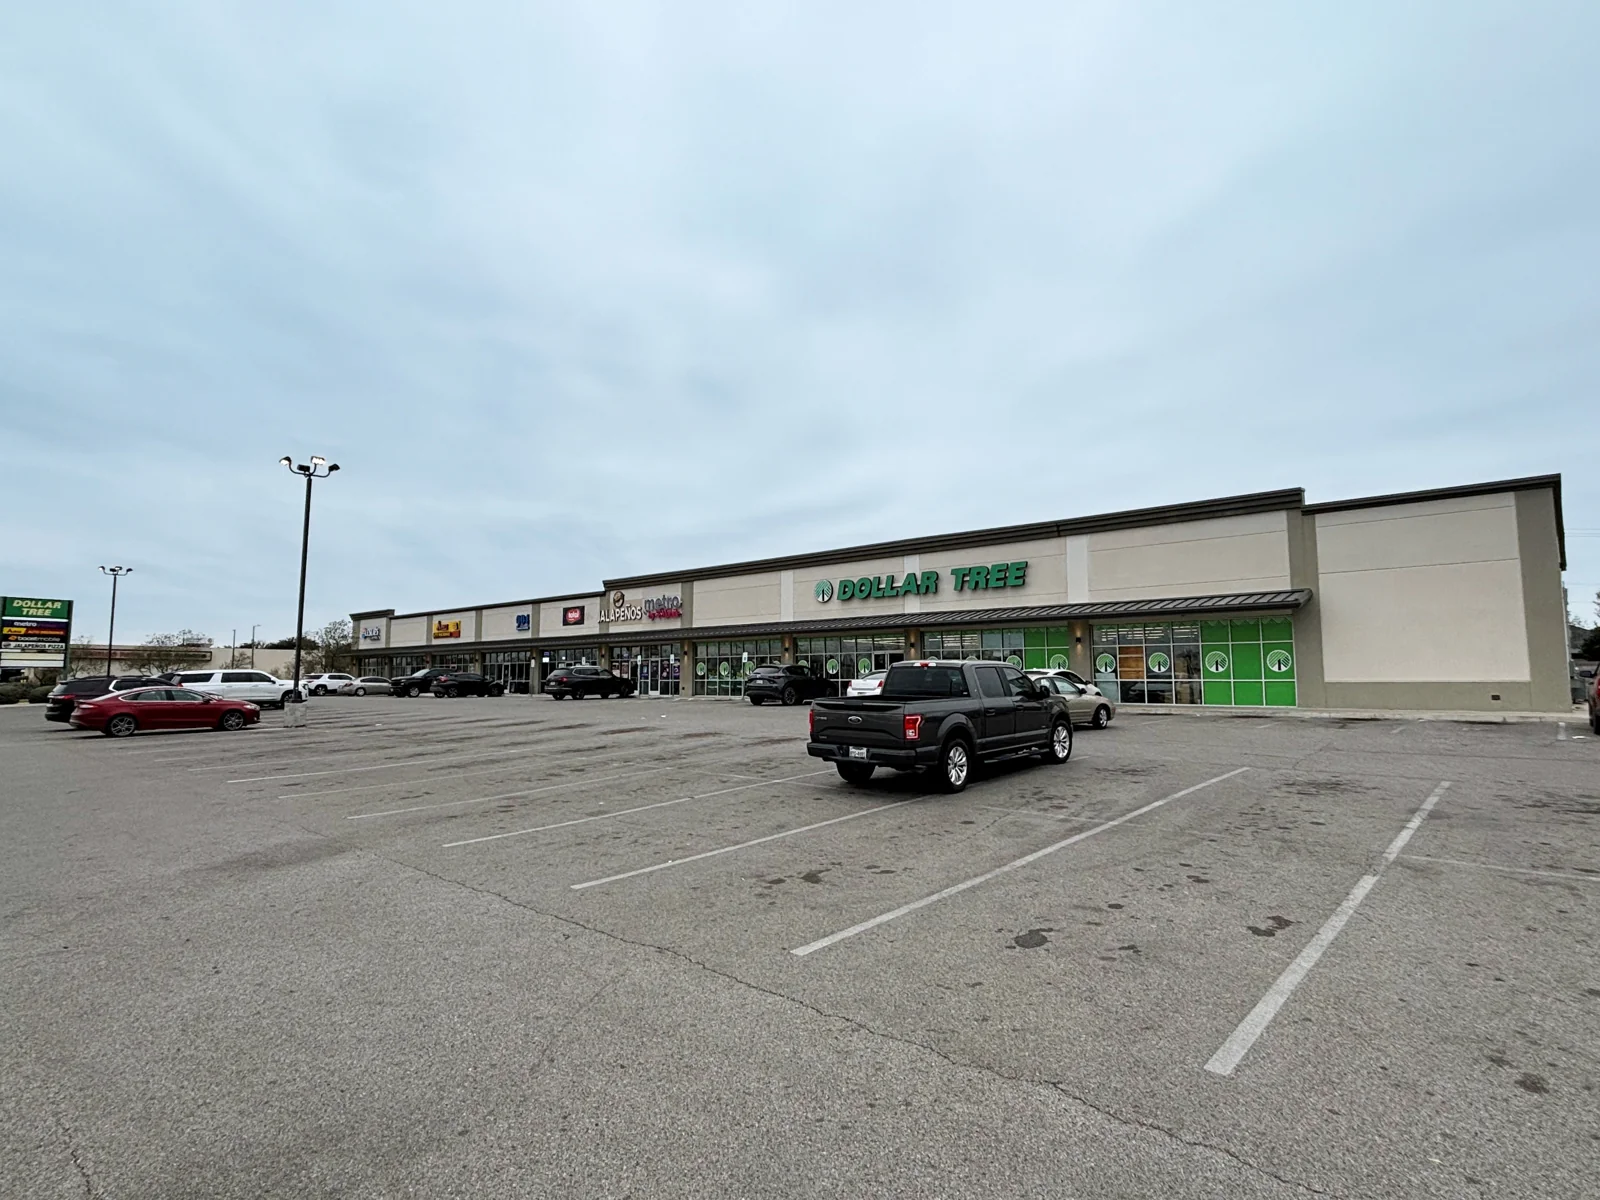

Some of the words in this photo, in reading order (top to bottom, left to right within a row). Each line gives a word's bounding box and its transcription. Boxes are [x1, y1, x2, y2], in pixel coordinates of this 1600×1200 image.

[837, 571, 938, 601] DOLLAR
[951, 561, 1028, 592] TREE
[13, 600, 62, 609] DOLLAR
[644, 594, 680, 612] metro
[22, 608, 52, 616] TREE
